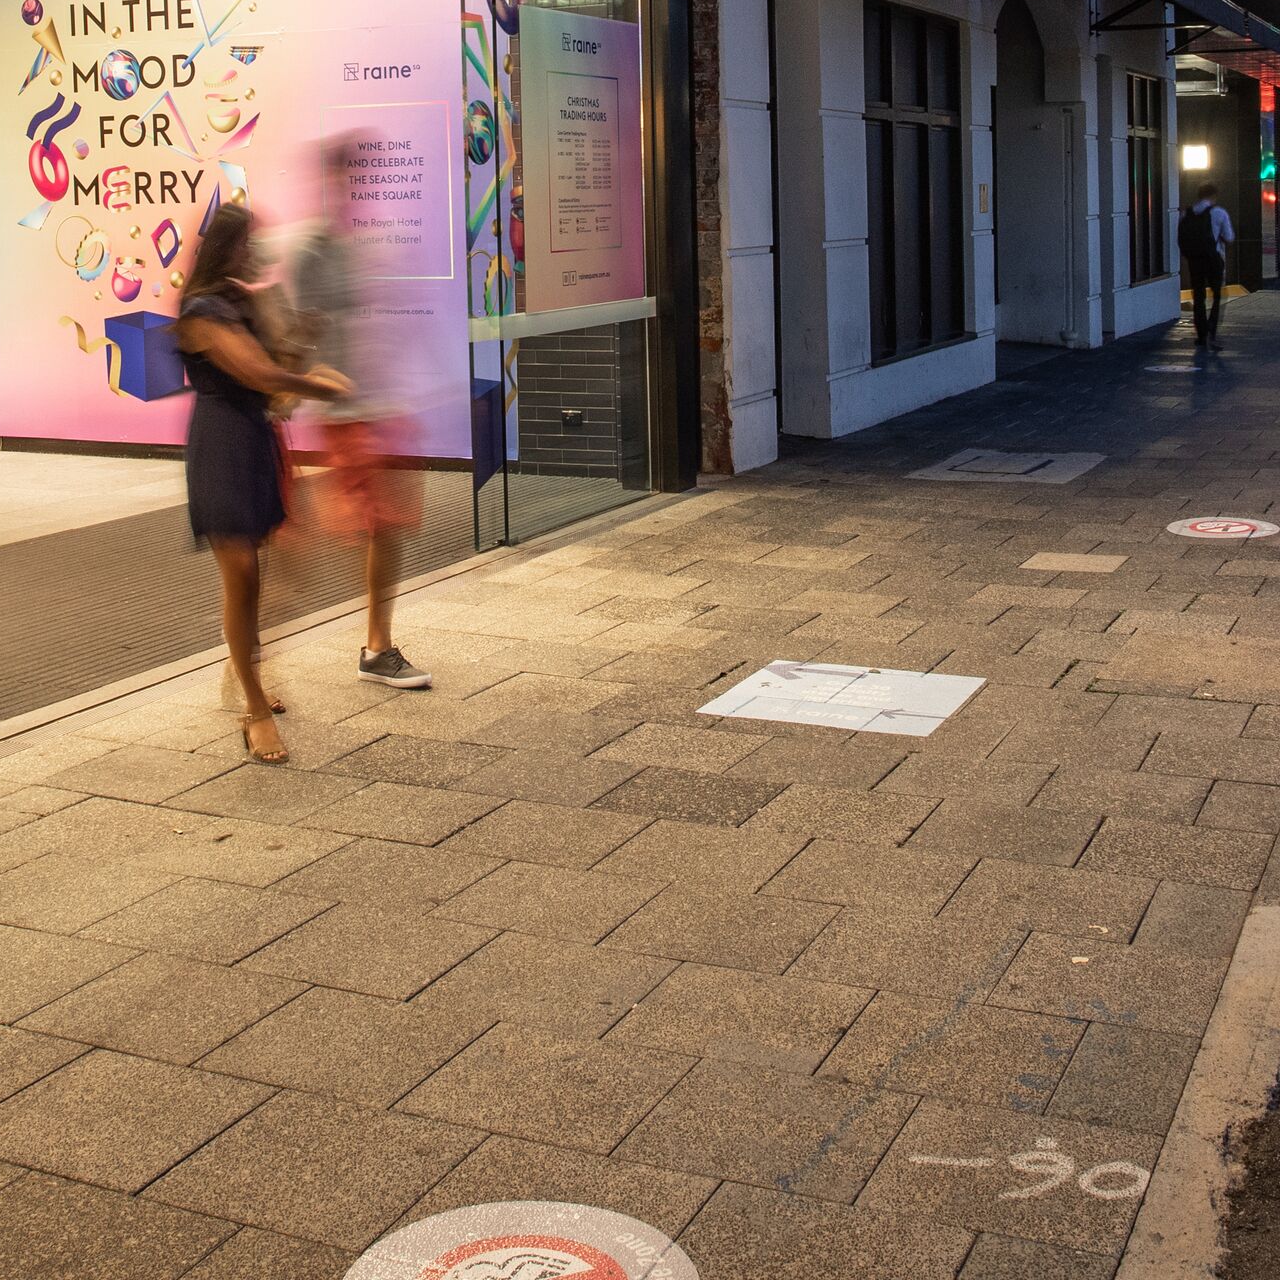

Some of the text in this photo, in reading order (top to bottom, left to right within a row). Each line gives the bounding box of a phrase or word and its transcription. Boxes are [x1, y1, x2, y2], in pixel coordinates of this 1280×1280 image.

[70, 1, 107, 37] IN
[572, 39, 597, 55] raine
[363, 64, 412, 80] raine
[567, 96, 600, 109] CHRISTMAS
[560, 109, 607, 122] TRADING HOURS
[99, 113, 173, 149] FOR
[357, 140, 412, 152] WINE, DINE
[347, 157, 425, 169] AND CELEBRATE
[349, 173, 424, 185] THE SEASON AT
[73, 165, 205, 213] MERRY
[351, 190, 423, 201] RAINE SQUARE
[352, 217, 422, 229] The Royal Hotel
[394, 234, 422, 245] Barrel
